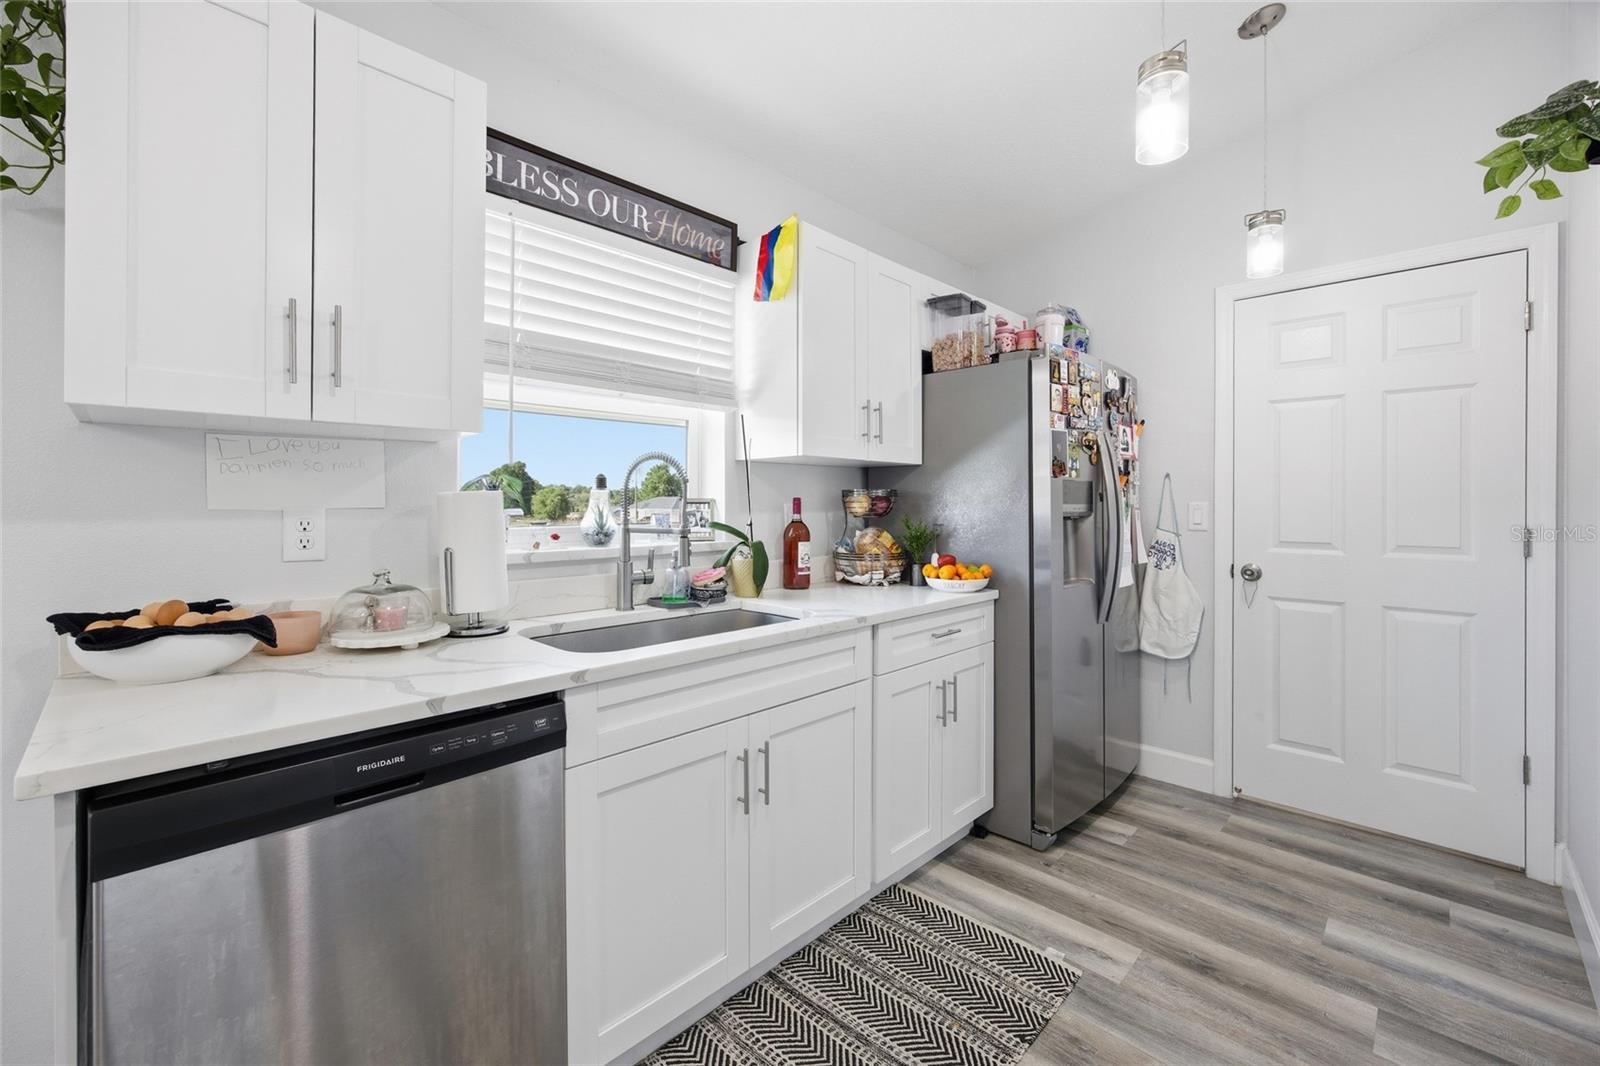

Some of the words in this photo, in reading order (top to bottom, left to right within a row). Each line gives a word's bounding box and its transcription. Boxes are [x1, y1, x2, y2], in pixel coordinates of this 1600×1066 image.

[588, 188, 650, 232] OUR
[645, 208, 725, 259] Home
[215, 436, 244, 461] I
[308, 438, 341, 454] you
[356, 754, 406, 773] FRIGIDAIRE
